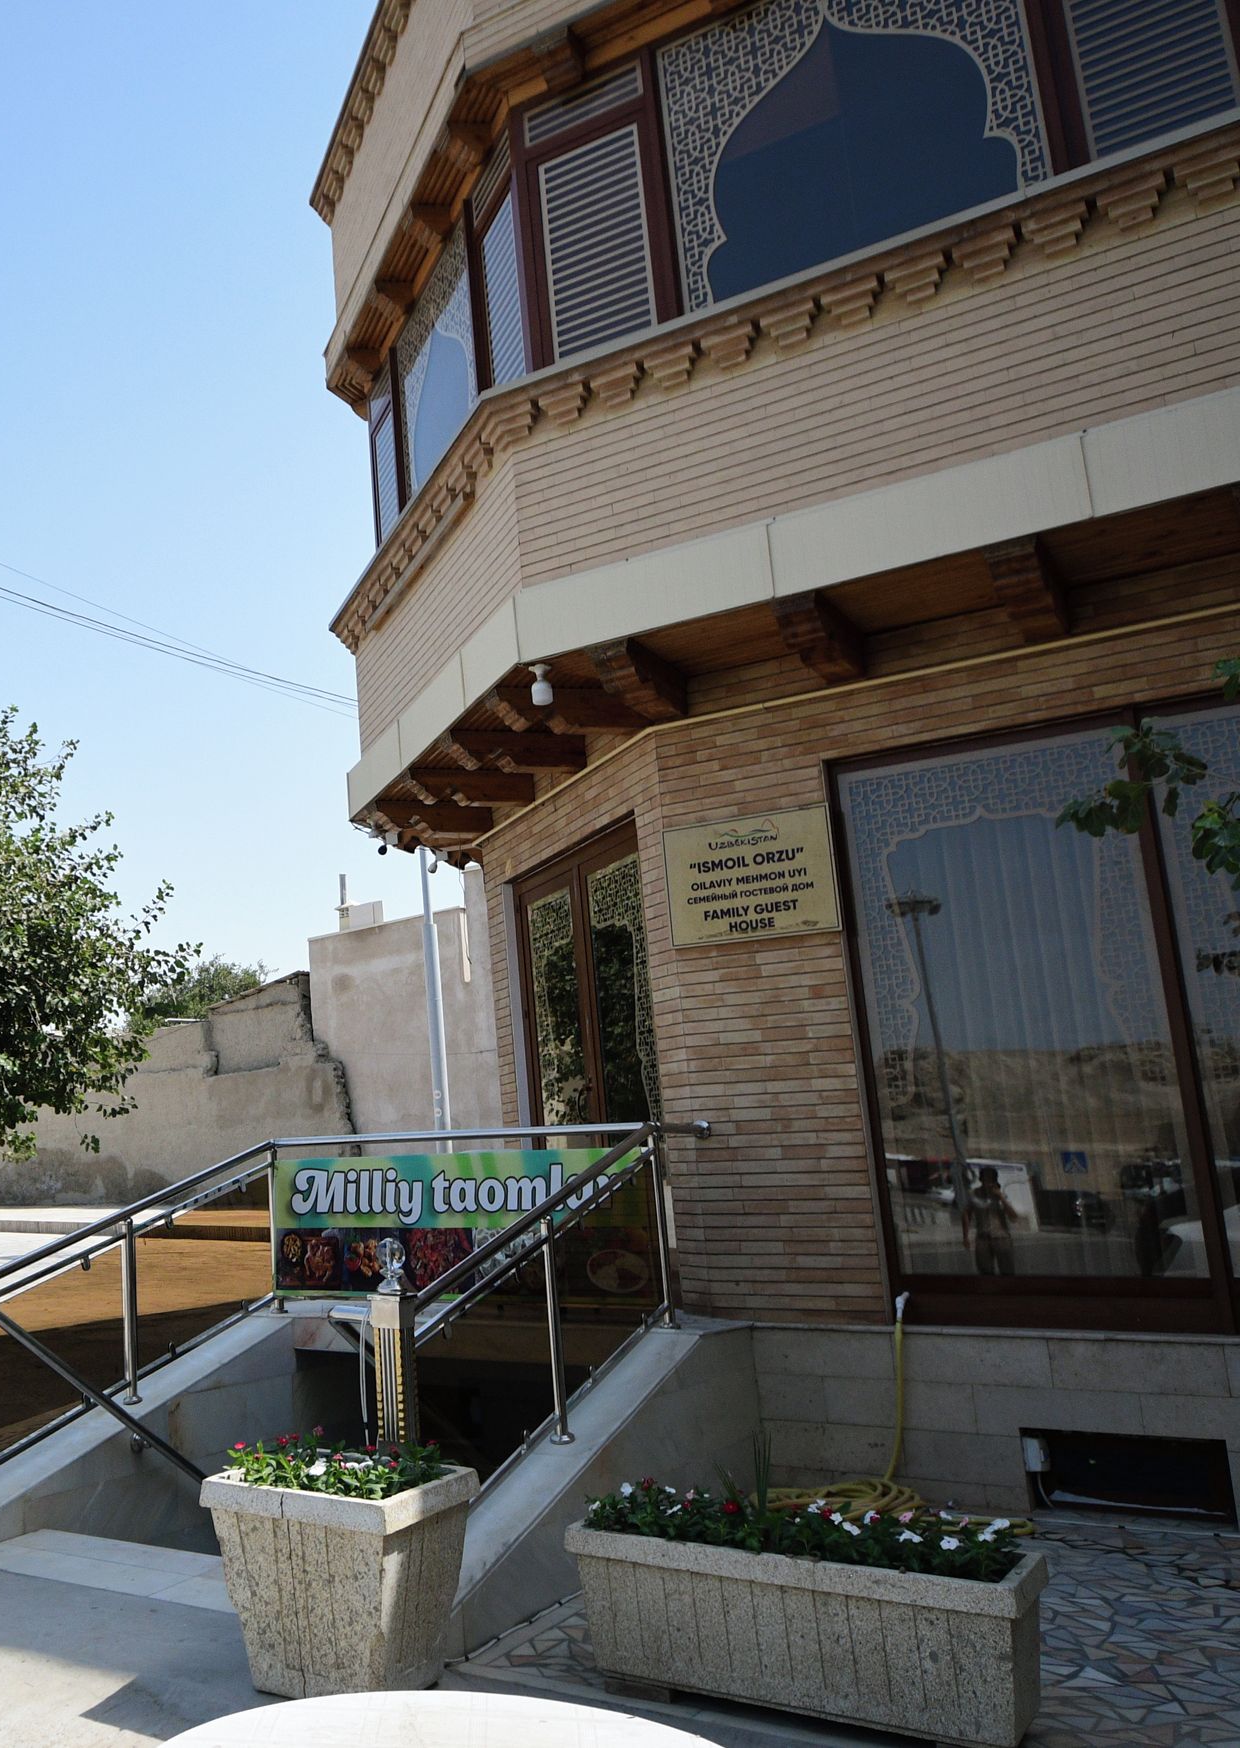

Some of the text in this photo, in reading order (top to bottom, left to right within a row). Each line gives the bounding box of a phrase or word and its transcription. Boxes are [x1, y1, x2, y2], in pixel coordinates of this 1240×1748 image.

[691, 867, 808, 892] OILAVIY MEHMON UYI
[687, 881, 814, 905] СЕМЕЙНЫЙ ГОСТЕВОЙ ДОМ
[704, 899, 799, 922] FAMILY GUEST
[729, 917, 776, 933] HOUSE
[291, 1168, 423, 1225] Milliy
